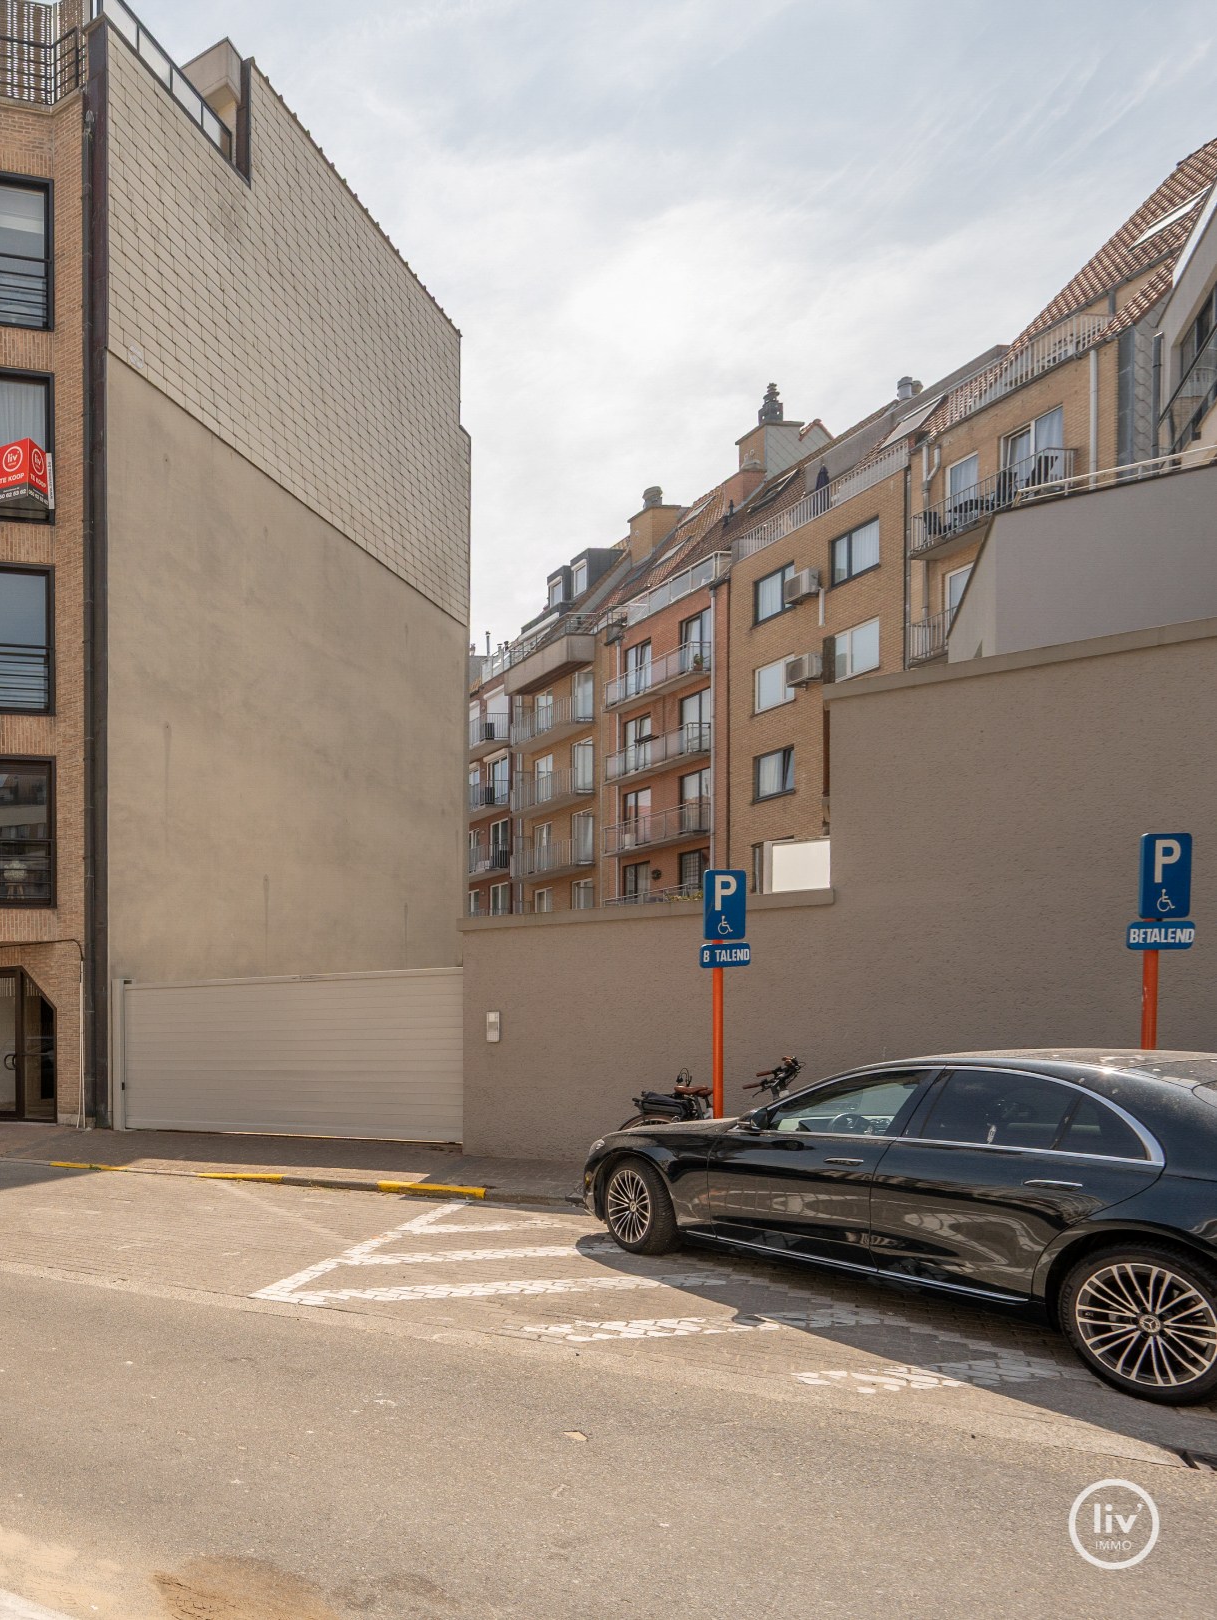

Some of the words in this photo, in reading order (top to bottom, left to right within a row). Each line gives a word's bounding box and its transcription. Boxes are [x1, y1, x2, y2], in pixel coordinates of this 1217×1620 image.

[8, 473, 25, 482] KOOP
[1154, 839, 1181, 883] P
[715, 875, 737, 911] P
[1129, 928, 1195, 943] BETALEND
